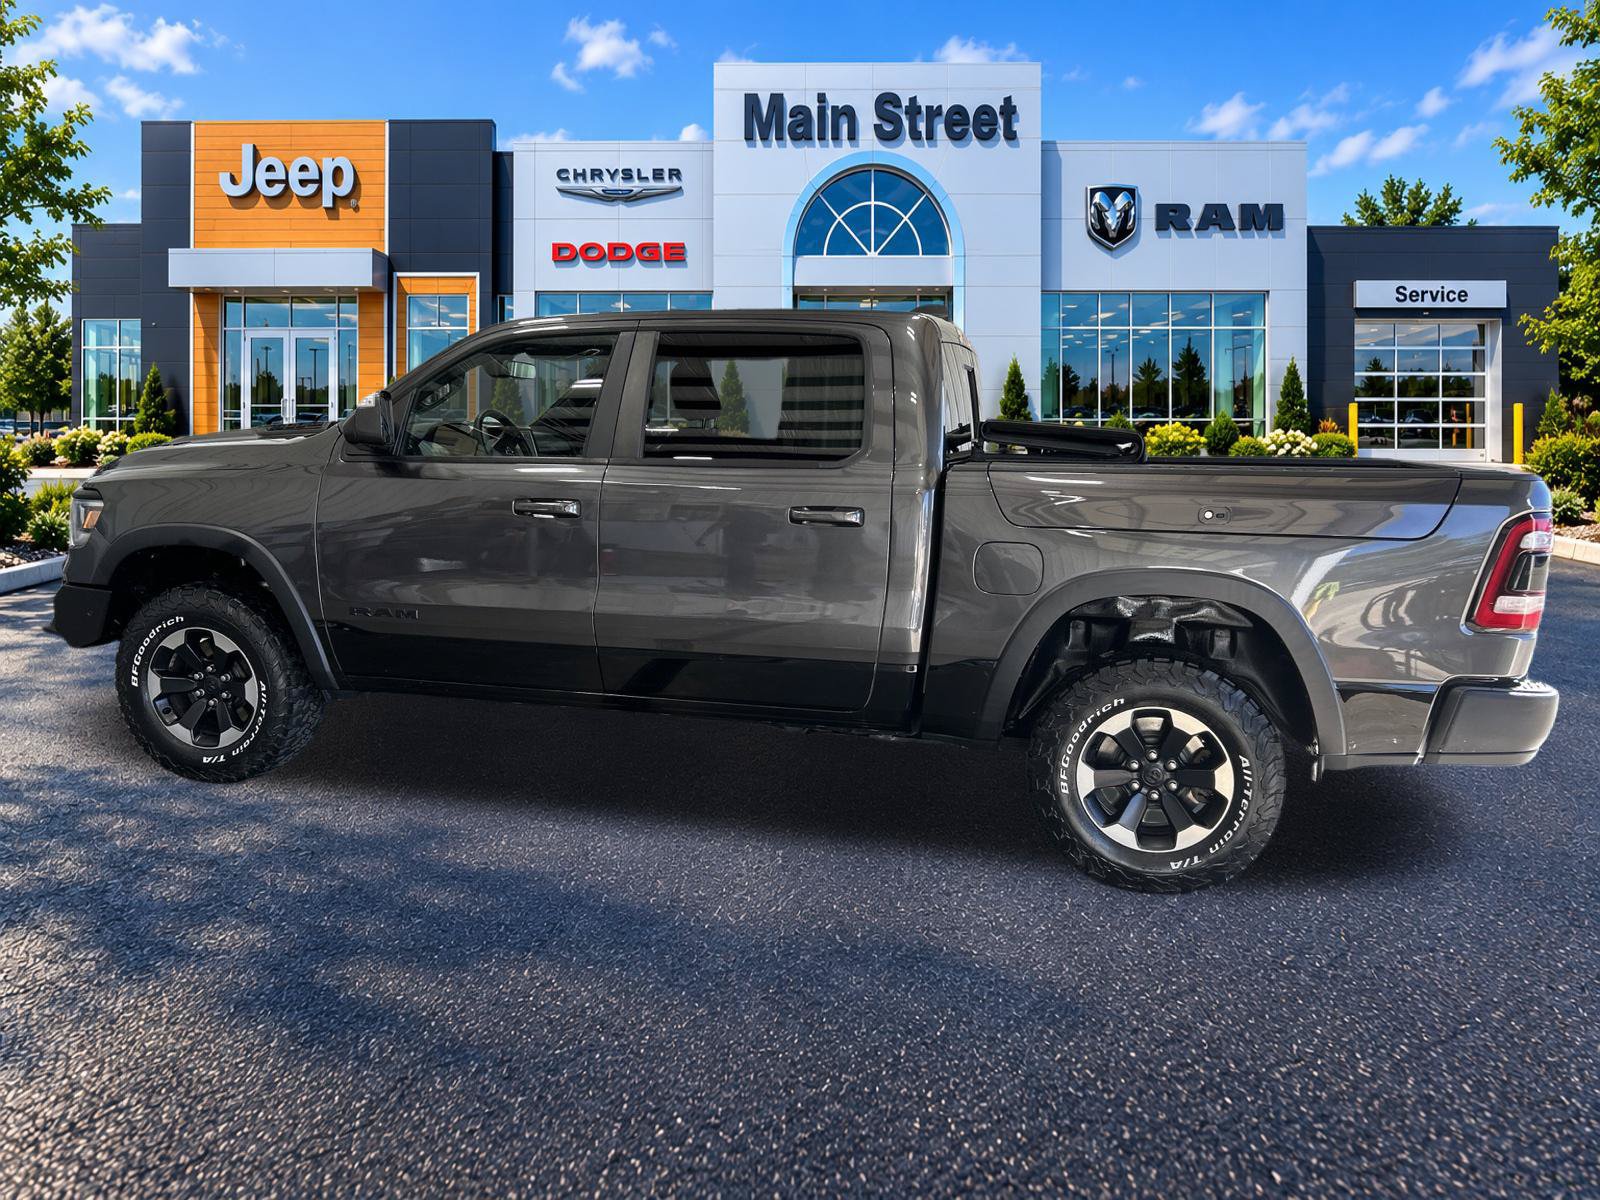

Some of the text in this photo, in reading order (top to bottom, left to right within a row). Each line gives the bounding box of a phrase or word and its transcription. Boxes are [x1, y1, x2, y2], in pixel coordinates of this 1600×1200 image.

[744, 92, 1019, 142] Main Street
[218, 143, 356, 209] Jeep
[556, 167, 682, 184] CHRYSLER
[1154, 203, 1284, 231] RAM
[551, 242, 686, 263] DODGE
[1395, 285, 1469, 303] Service
[349, 606, 419, 620] RAM
[131, 615, 184, 687] BFGoodrich
[1060, 697, 1126, 795] BFGoodrich
[202, 754, 226, 764] T/A
[1169, 855, 1202, 871] T/A
